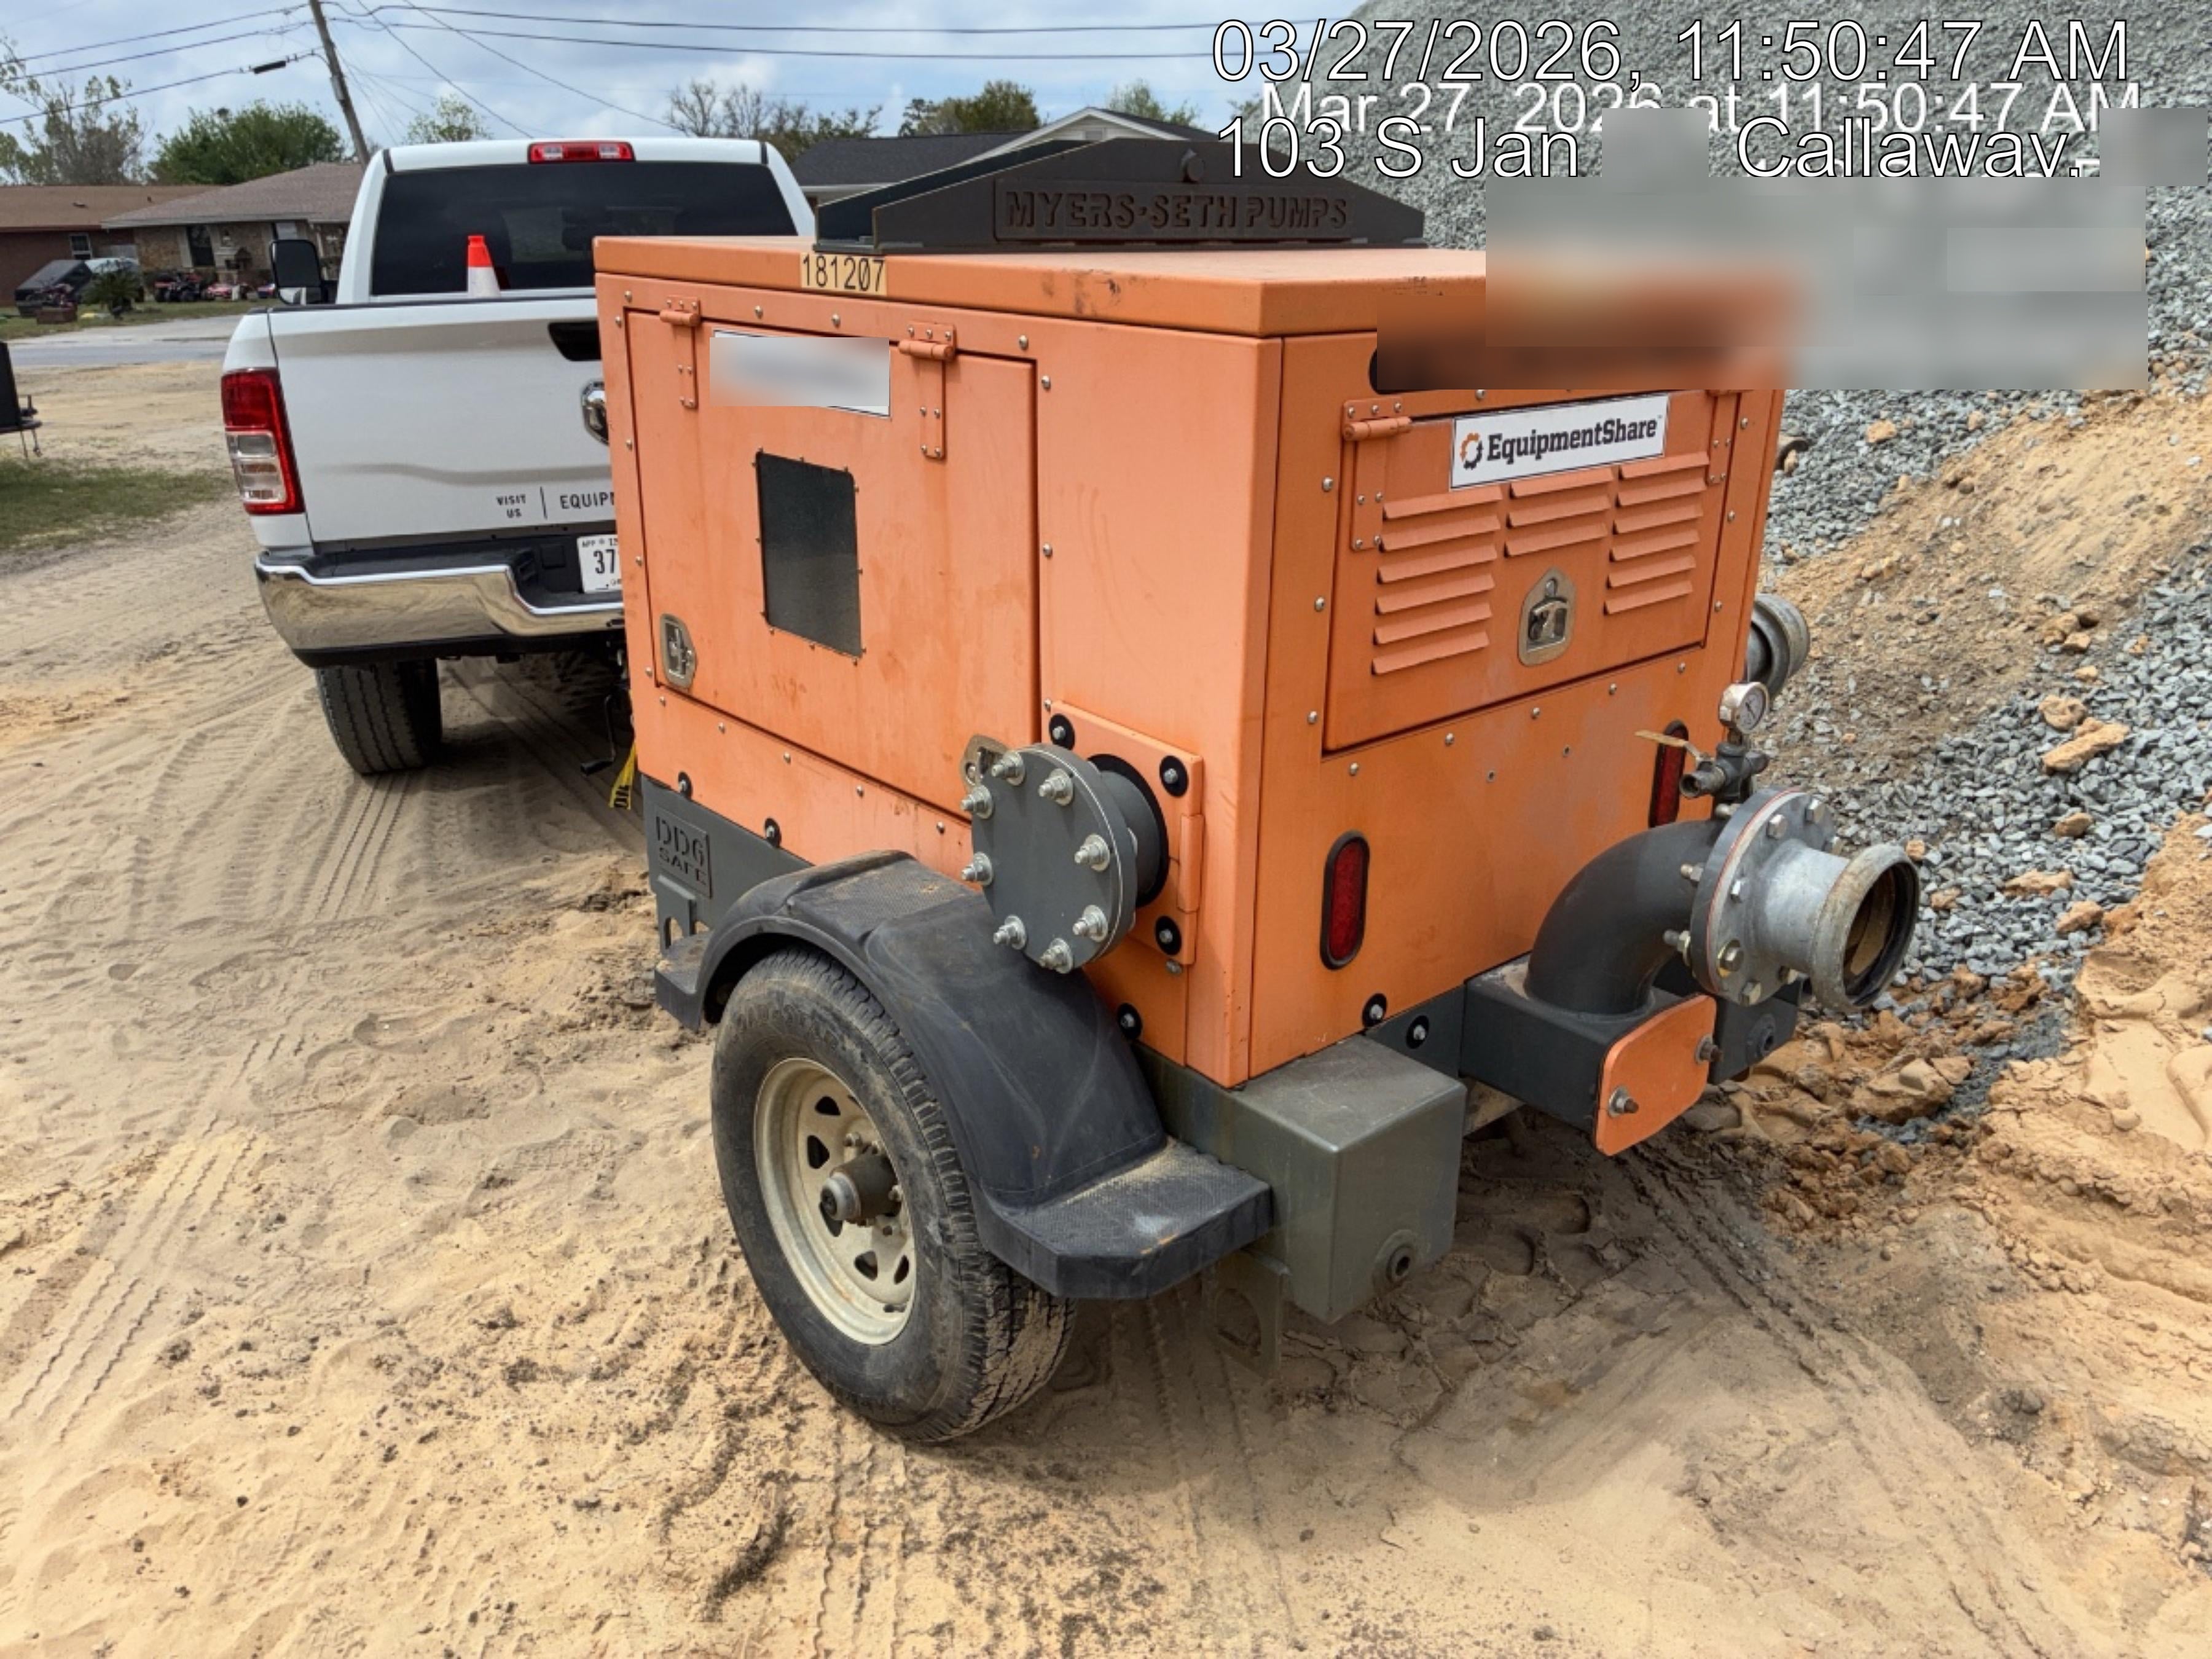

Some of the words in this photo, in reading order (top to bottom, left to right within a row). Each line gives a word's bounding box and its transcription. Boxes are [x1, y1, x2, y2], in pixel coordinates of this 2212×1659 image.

[1245, 196, 1347, 228] PUMPS
[803, 254, 885, 292] 181207
[1486, 418, 1657, 465] EquipmentShare
[496, 494, 526, 506] VISIT
[506, 508, 522, 519] US
[593, 549, 616, 574] 37
